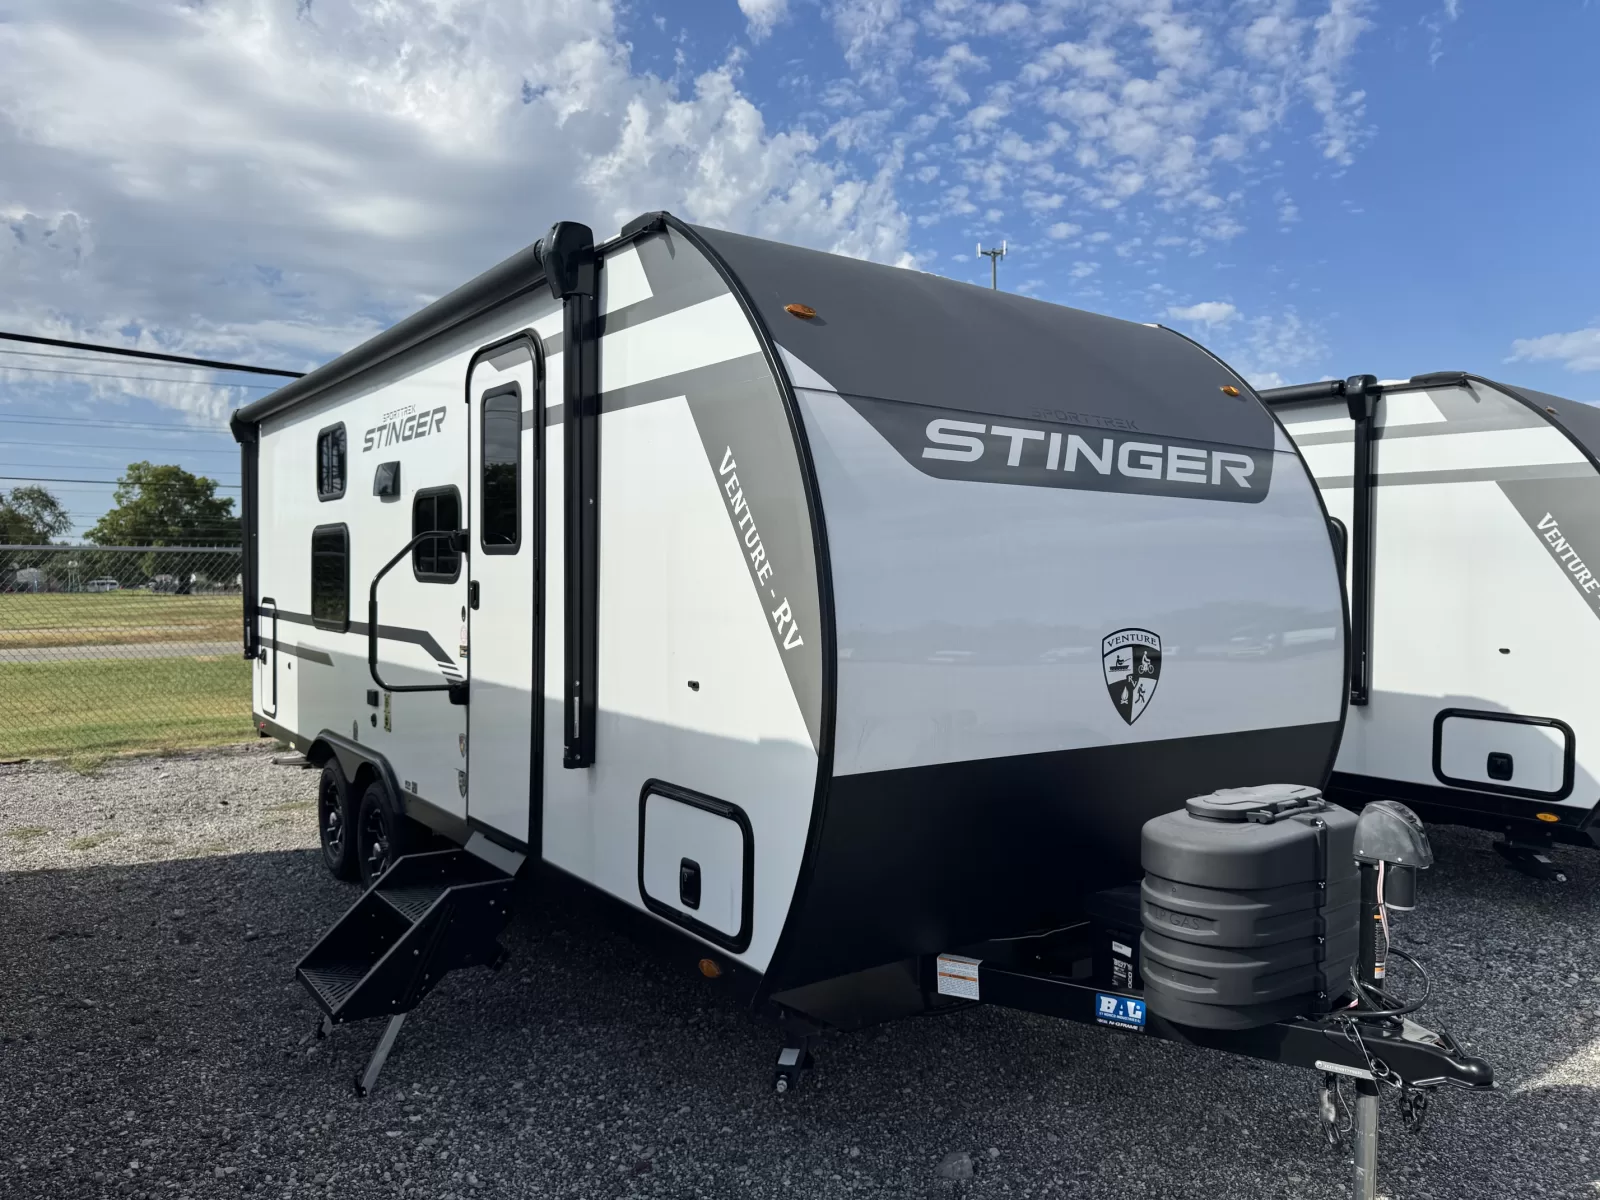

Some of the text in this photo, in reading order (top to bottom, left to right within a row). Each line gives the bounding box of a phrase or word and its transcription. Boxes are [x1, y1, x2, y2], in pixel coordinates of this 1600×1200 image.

[362, 405, 447, 453] STINGER
[921, 418, 1256, 489] STINGER
[718, 445, 774, 587] VENTURE
[771, 596, 804, 651] RV
[1536, 511, 1600, 594] VENTURE
[1107, 633, 1157, 647] VENTURE
[1170, 913, 1200, 930] GAS
[1099, 995, 1142, 1020] BAL
